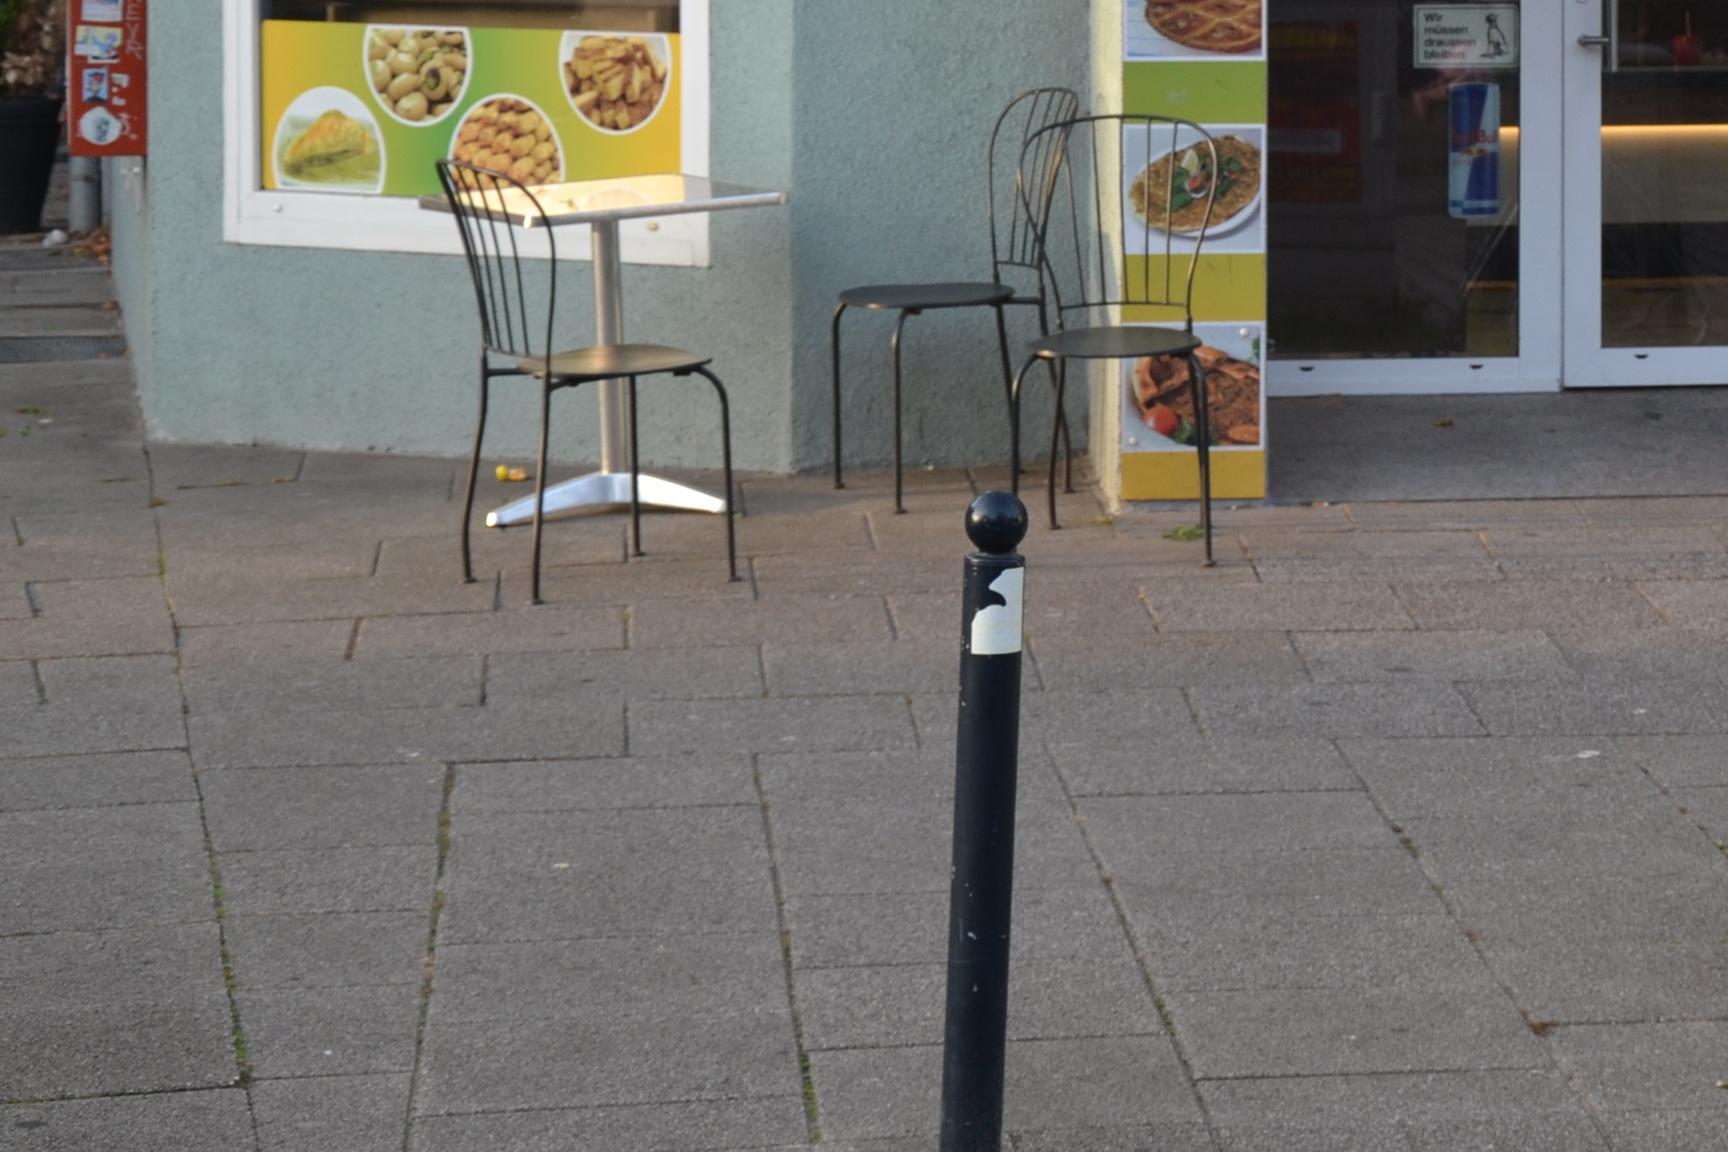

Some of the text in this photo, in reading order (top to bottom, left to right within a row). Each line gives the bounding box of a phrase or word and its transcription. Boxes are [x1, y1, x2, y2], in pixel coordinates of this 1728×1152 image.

[1424, 12, 1443, 22] Wir
[1424, 25, 1469, 35] müssen
[1424, 50, 1466, 59] bleiben
